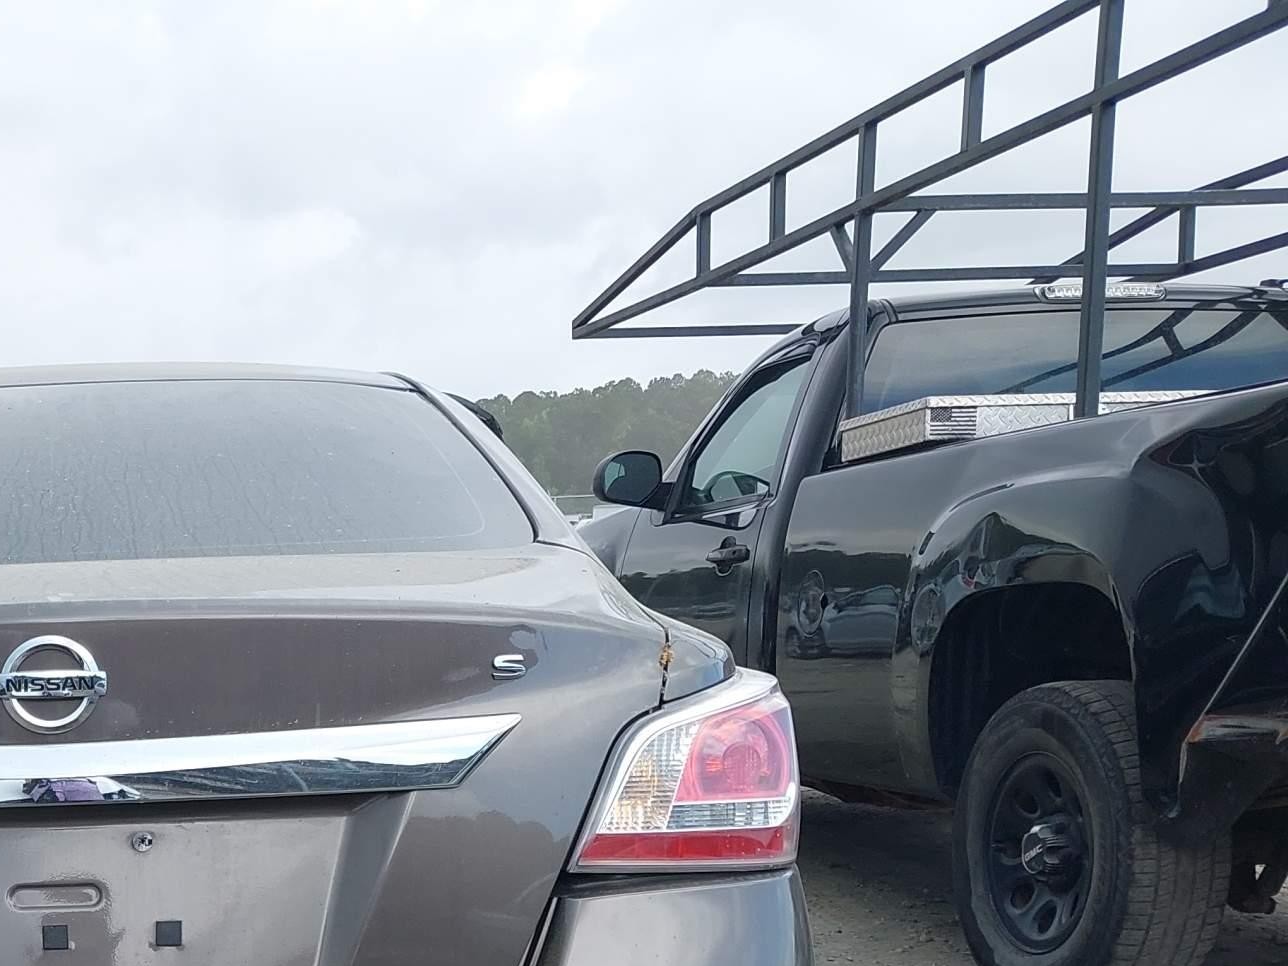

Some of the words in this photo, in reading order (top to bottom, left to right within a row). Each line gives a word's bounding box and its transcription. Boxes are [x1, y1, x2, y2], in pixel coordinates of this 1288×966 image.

[492, 654, 526, 680] S
[5, 677, 96, 693] NISSAN
[1024, 843, 1044, 862] GMC
